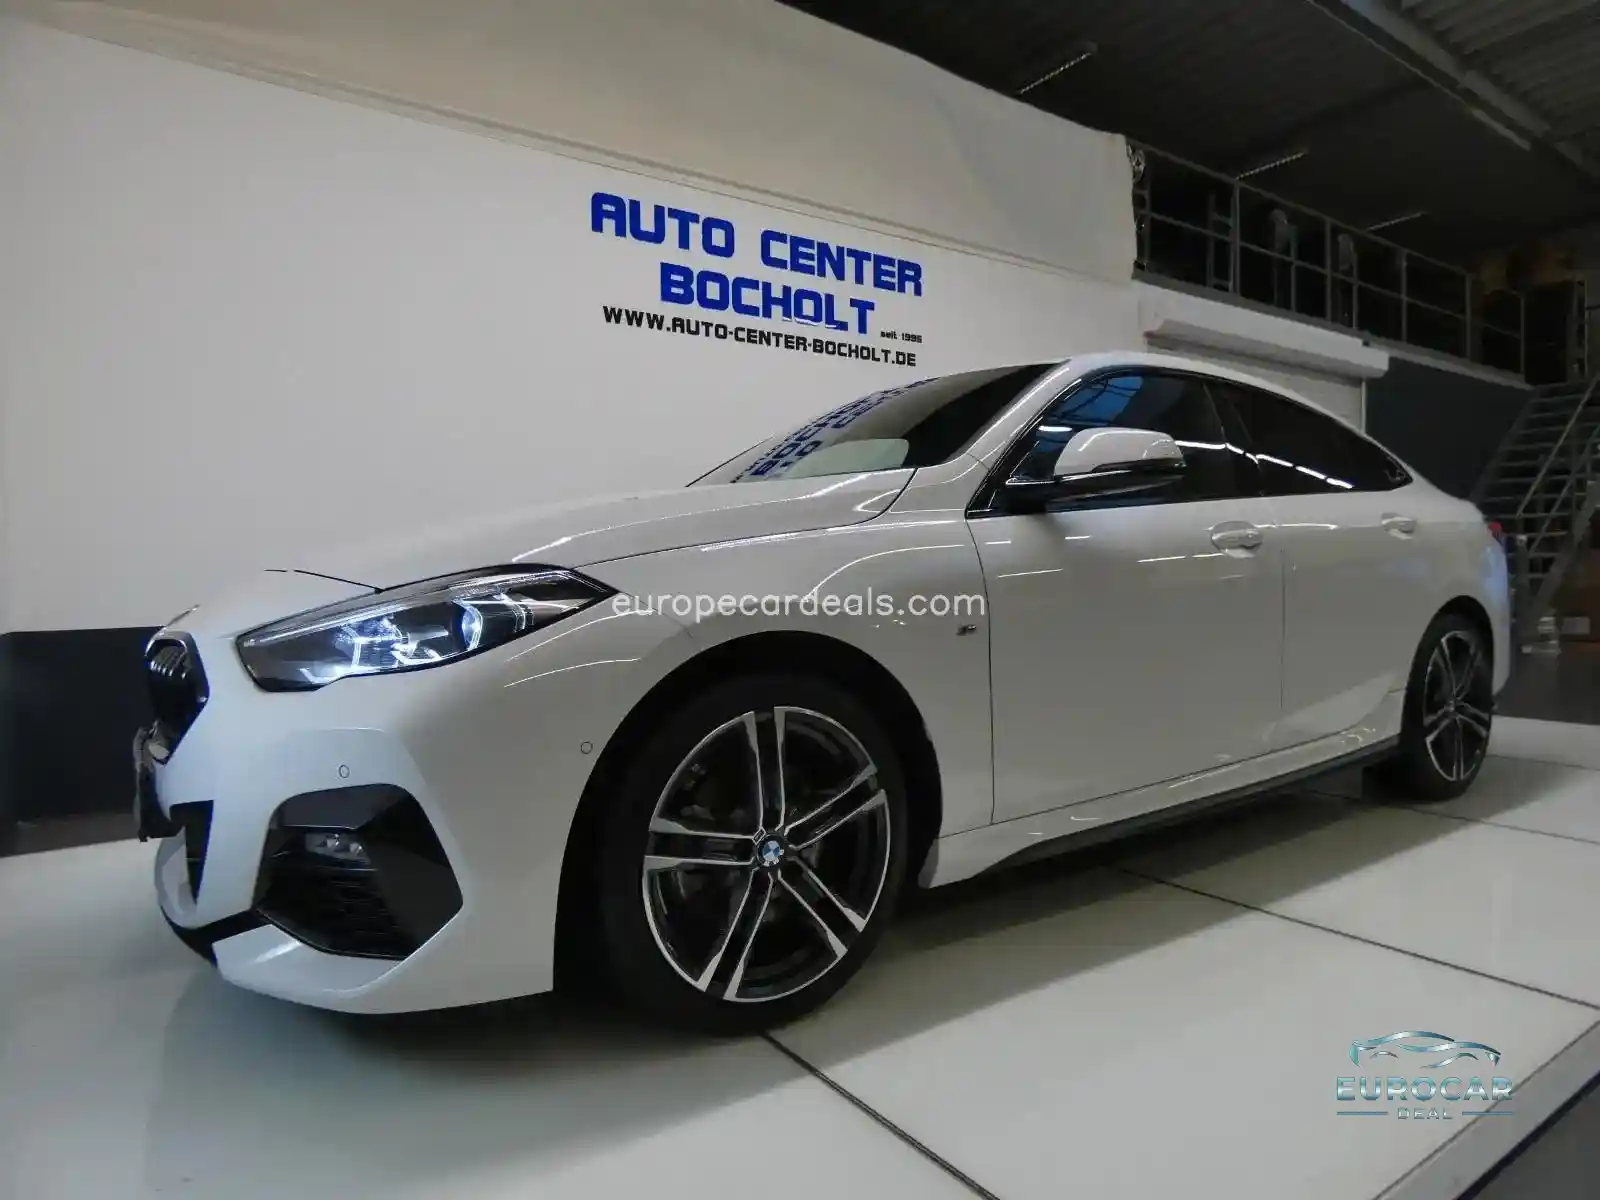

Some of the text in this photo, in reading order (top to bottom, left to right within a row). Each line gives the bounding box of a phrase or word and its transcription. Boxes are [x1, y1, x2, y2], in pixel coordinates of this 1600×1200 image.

[591, 192, 923, 297] AUTO CENTER
[660, 262, 876, 335] BOCHOLT
[602, 305, 917, 367] WWW.AUTO-CENTER-BOCHOLT.DE
[880, 330, 898, 340] seit
